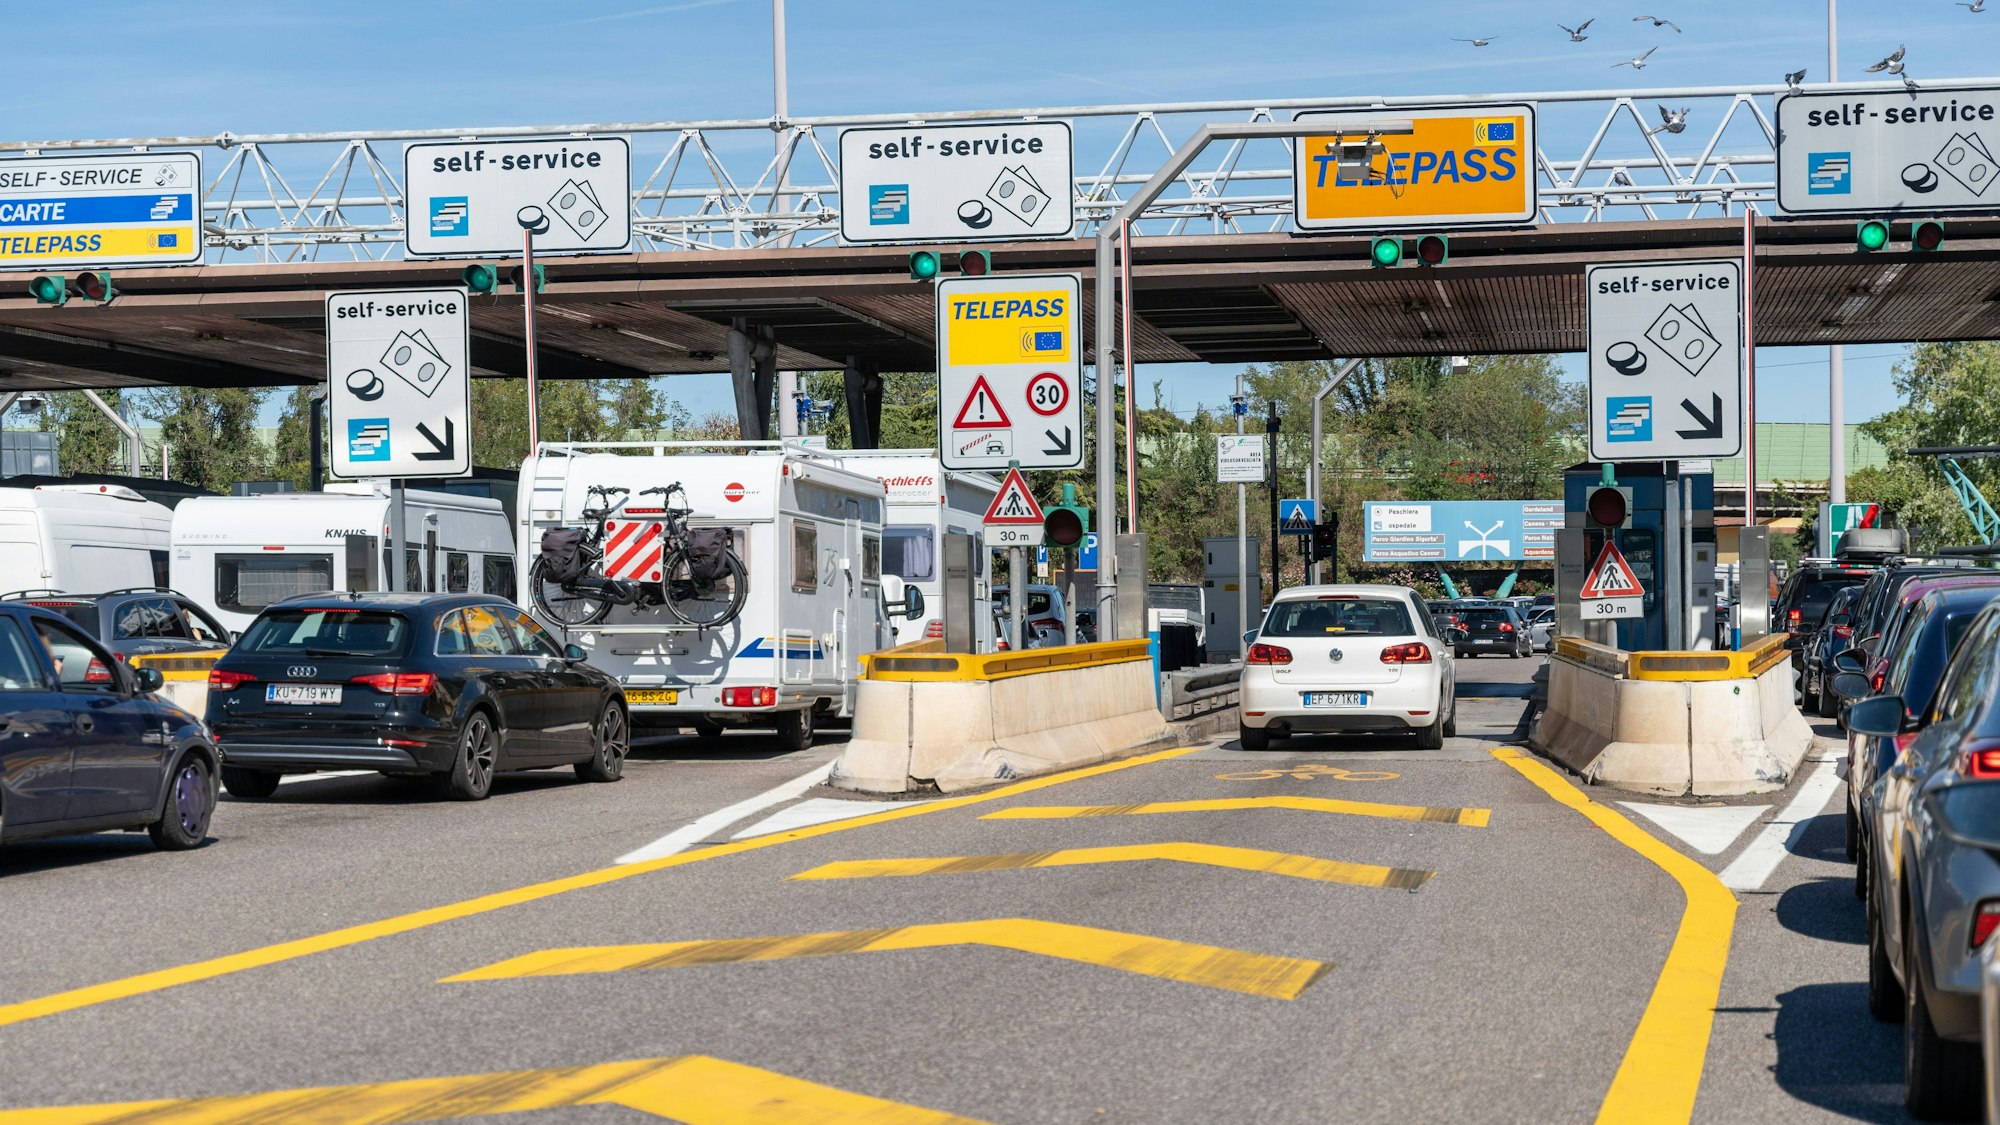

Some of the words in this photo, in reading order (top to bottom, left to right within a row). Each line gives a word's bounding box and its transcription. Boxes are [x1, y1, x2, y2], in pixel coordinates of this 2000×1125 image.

[1807, 99, 1995, 127] self-service
[868, 133, 1044, 159] self-service
[433, 147, 601, 173] self-service
[1312, 147, 1517, 188] TEPASS
[0, 168, 143, 188] SELF-SERVICE
[0, 202, 67, 222] CARTE
[0, 234, 102, 254] TELEPASS
[1598, 273, 1730, 294] self-service
[337, 299, 457, 319] self-service
[953, 298, 1064, 320] TELEPASS
[1035, 384, 1060, 405] 30
[1000, 531, 1017, 541] 30
[1020, 533, 1030, 541] m
[1596, 603, 1614, 614] 30
[275, 686, 289, 698] KU
[299, 687, 317, 699] 719
[320, 688, 336, 699] WY
[626, 691, 672, 701] 16-BS-ZG
[1311, 693, 1324, 704] EP
[1327, 693, 1359, 704] 671KR
